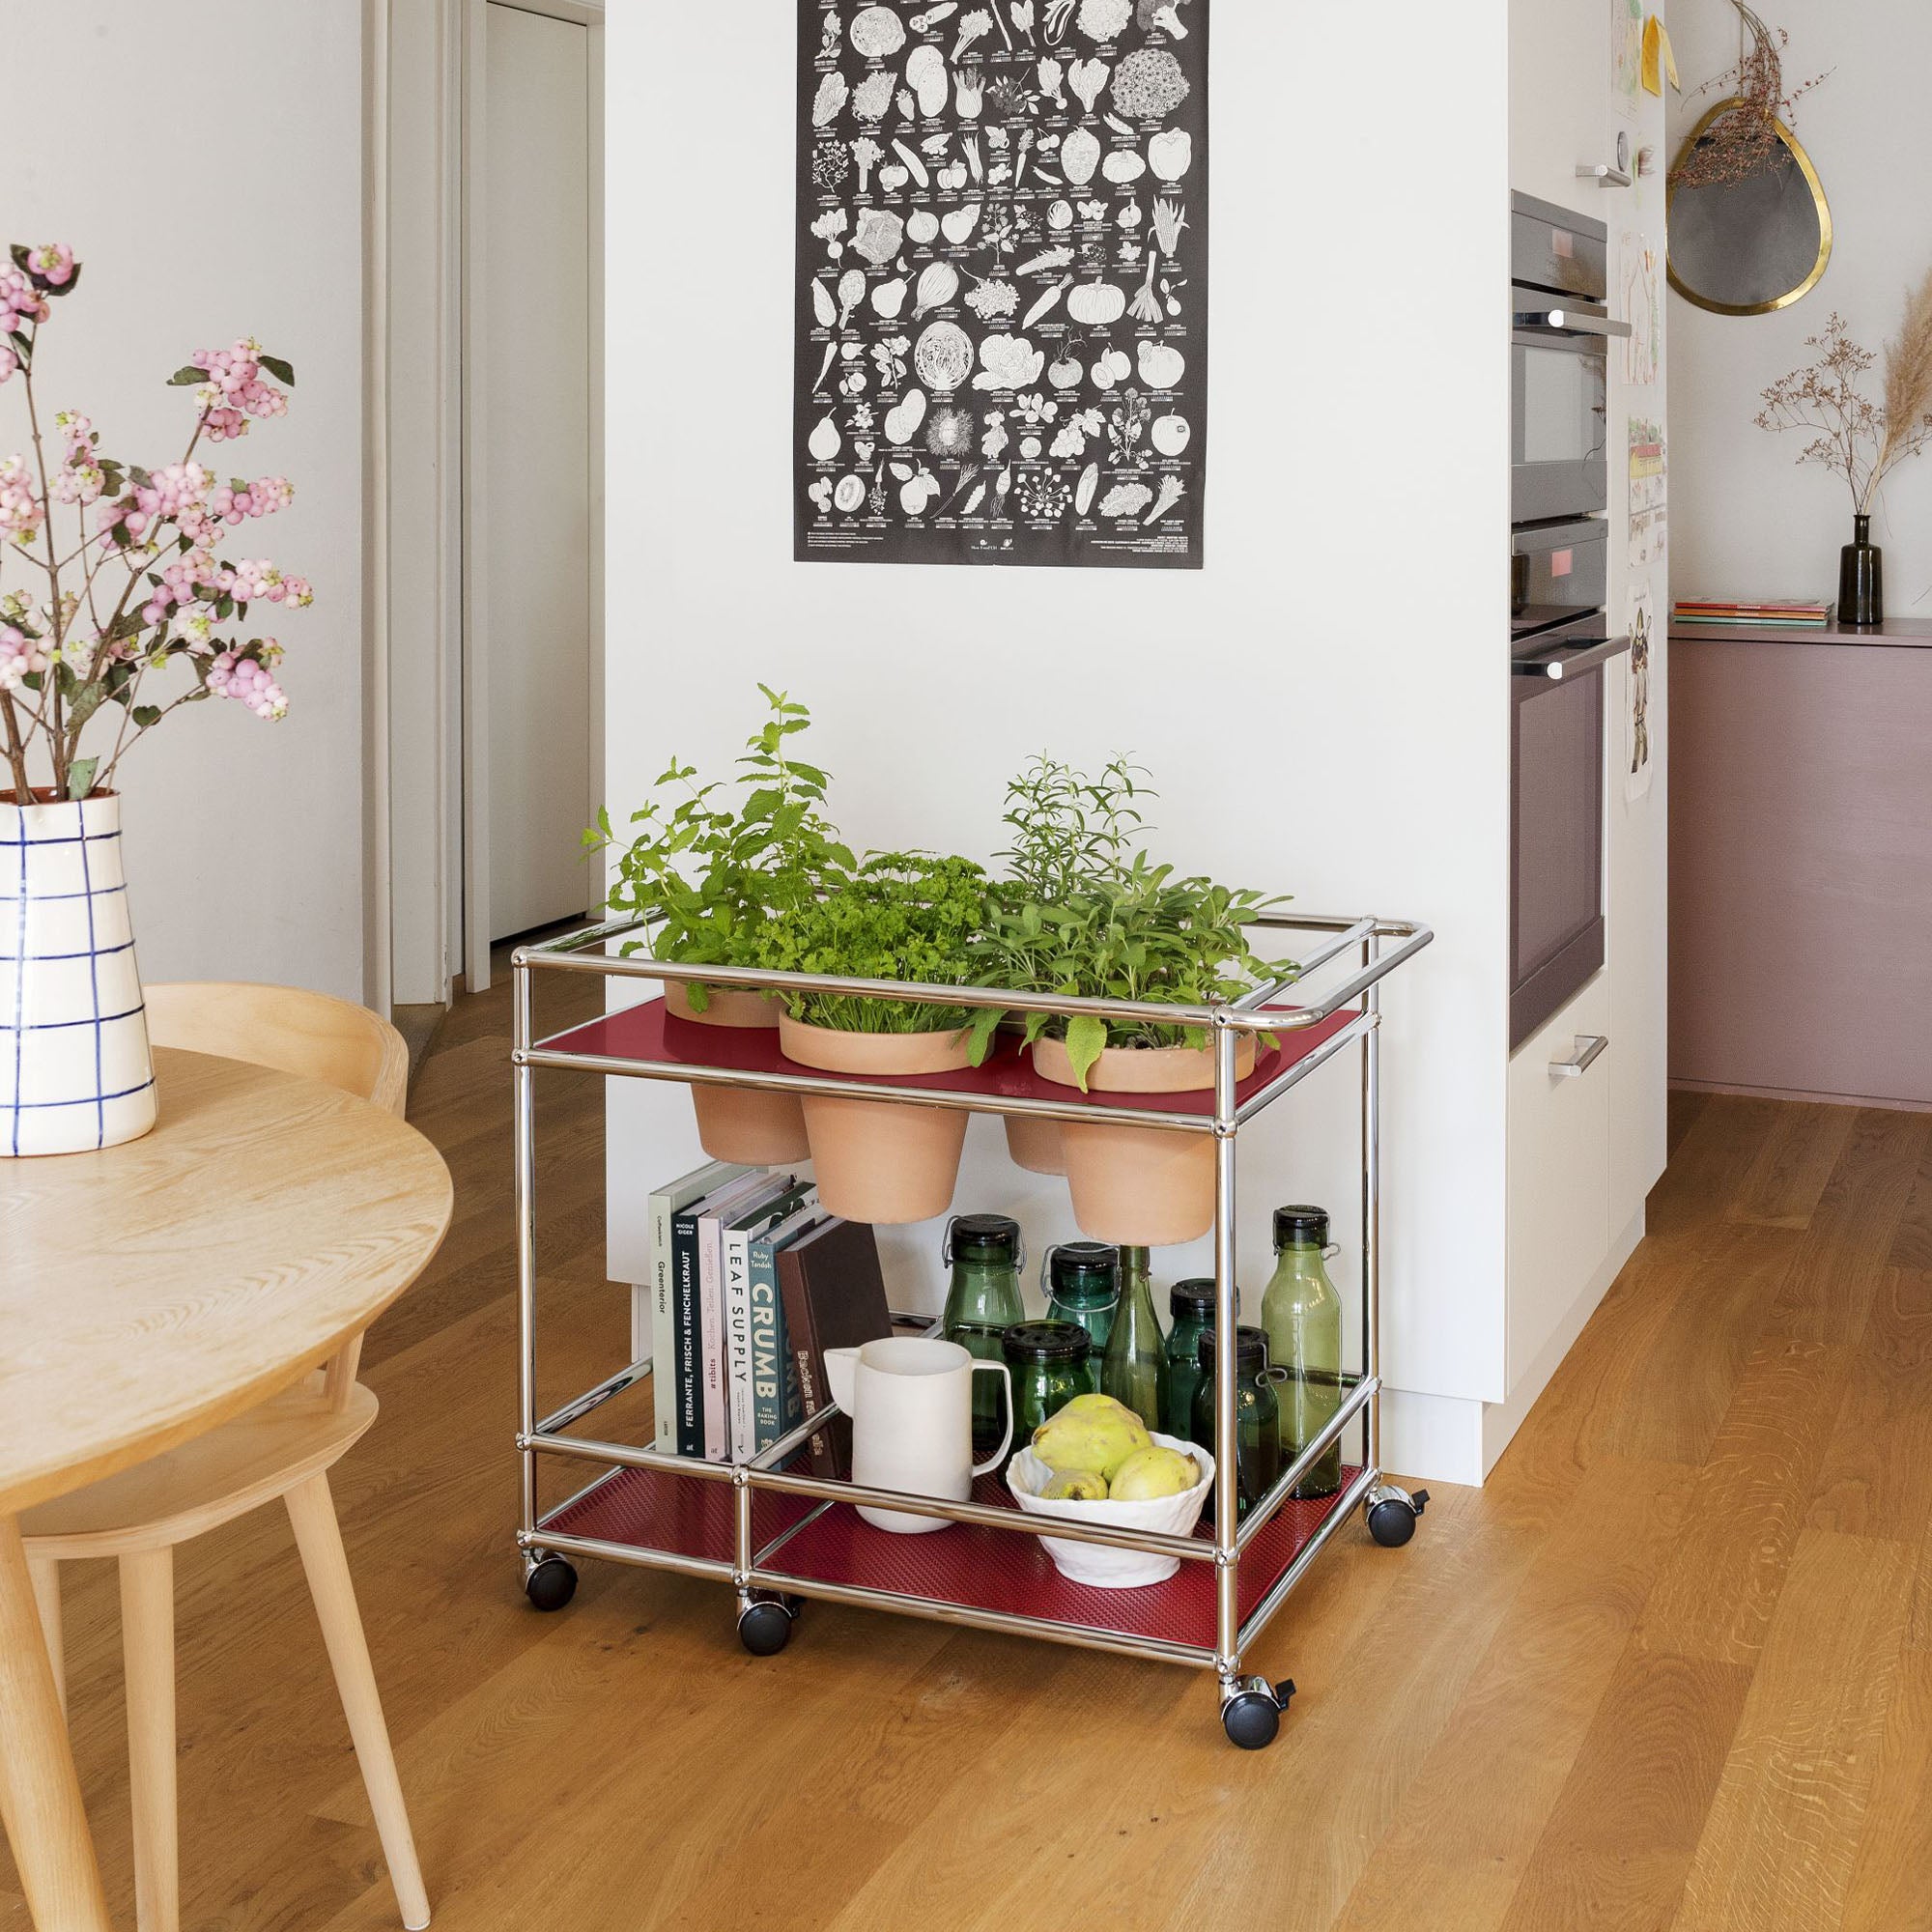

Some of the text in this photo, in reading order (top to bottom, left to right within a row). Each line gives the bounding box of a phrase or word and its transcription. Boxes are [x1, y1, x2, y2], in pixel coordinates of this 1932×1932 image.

[729, 1243, 743, 1296] LEAF
[753, 1251, 769, 1262] Ruby
[657, 1261, 667, 1314] Greenterior
[682, 1251, 692, 1326] FENCHELKRAUT
[684, 1338, 694, 1373] FRISCH
[732, 1306, 747, 1382] SUPPLY
[752, 1283, 777, 1399] CRUMB
[684, 1374, 695, 1428] FERRANTE,
[797, 1350, 813, 1399] Backen
